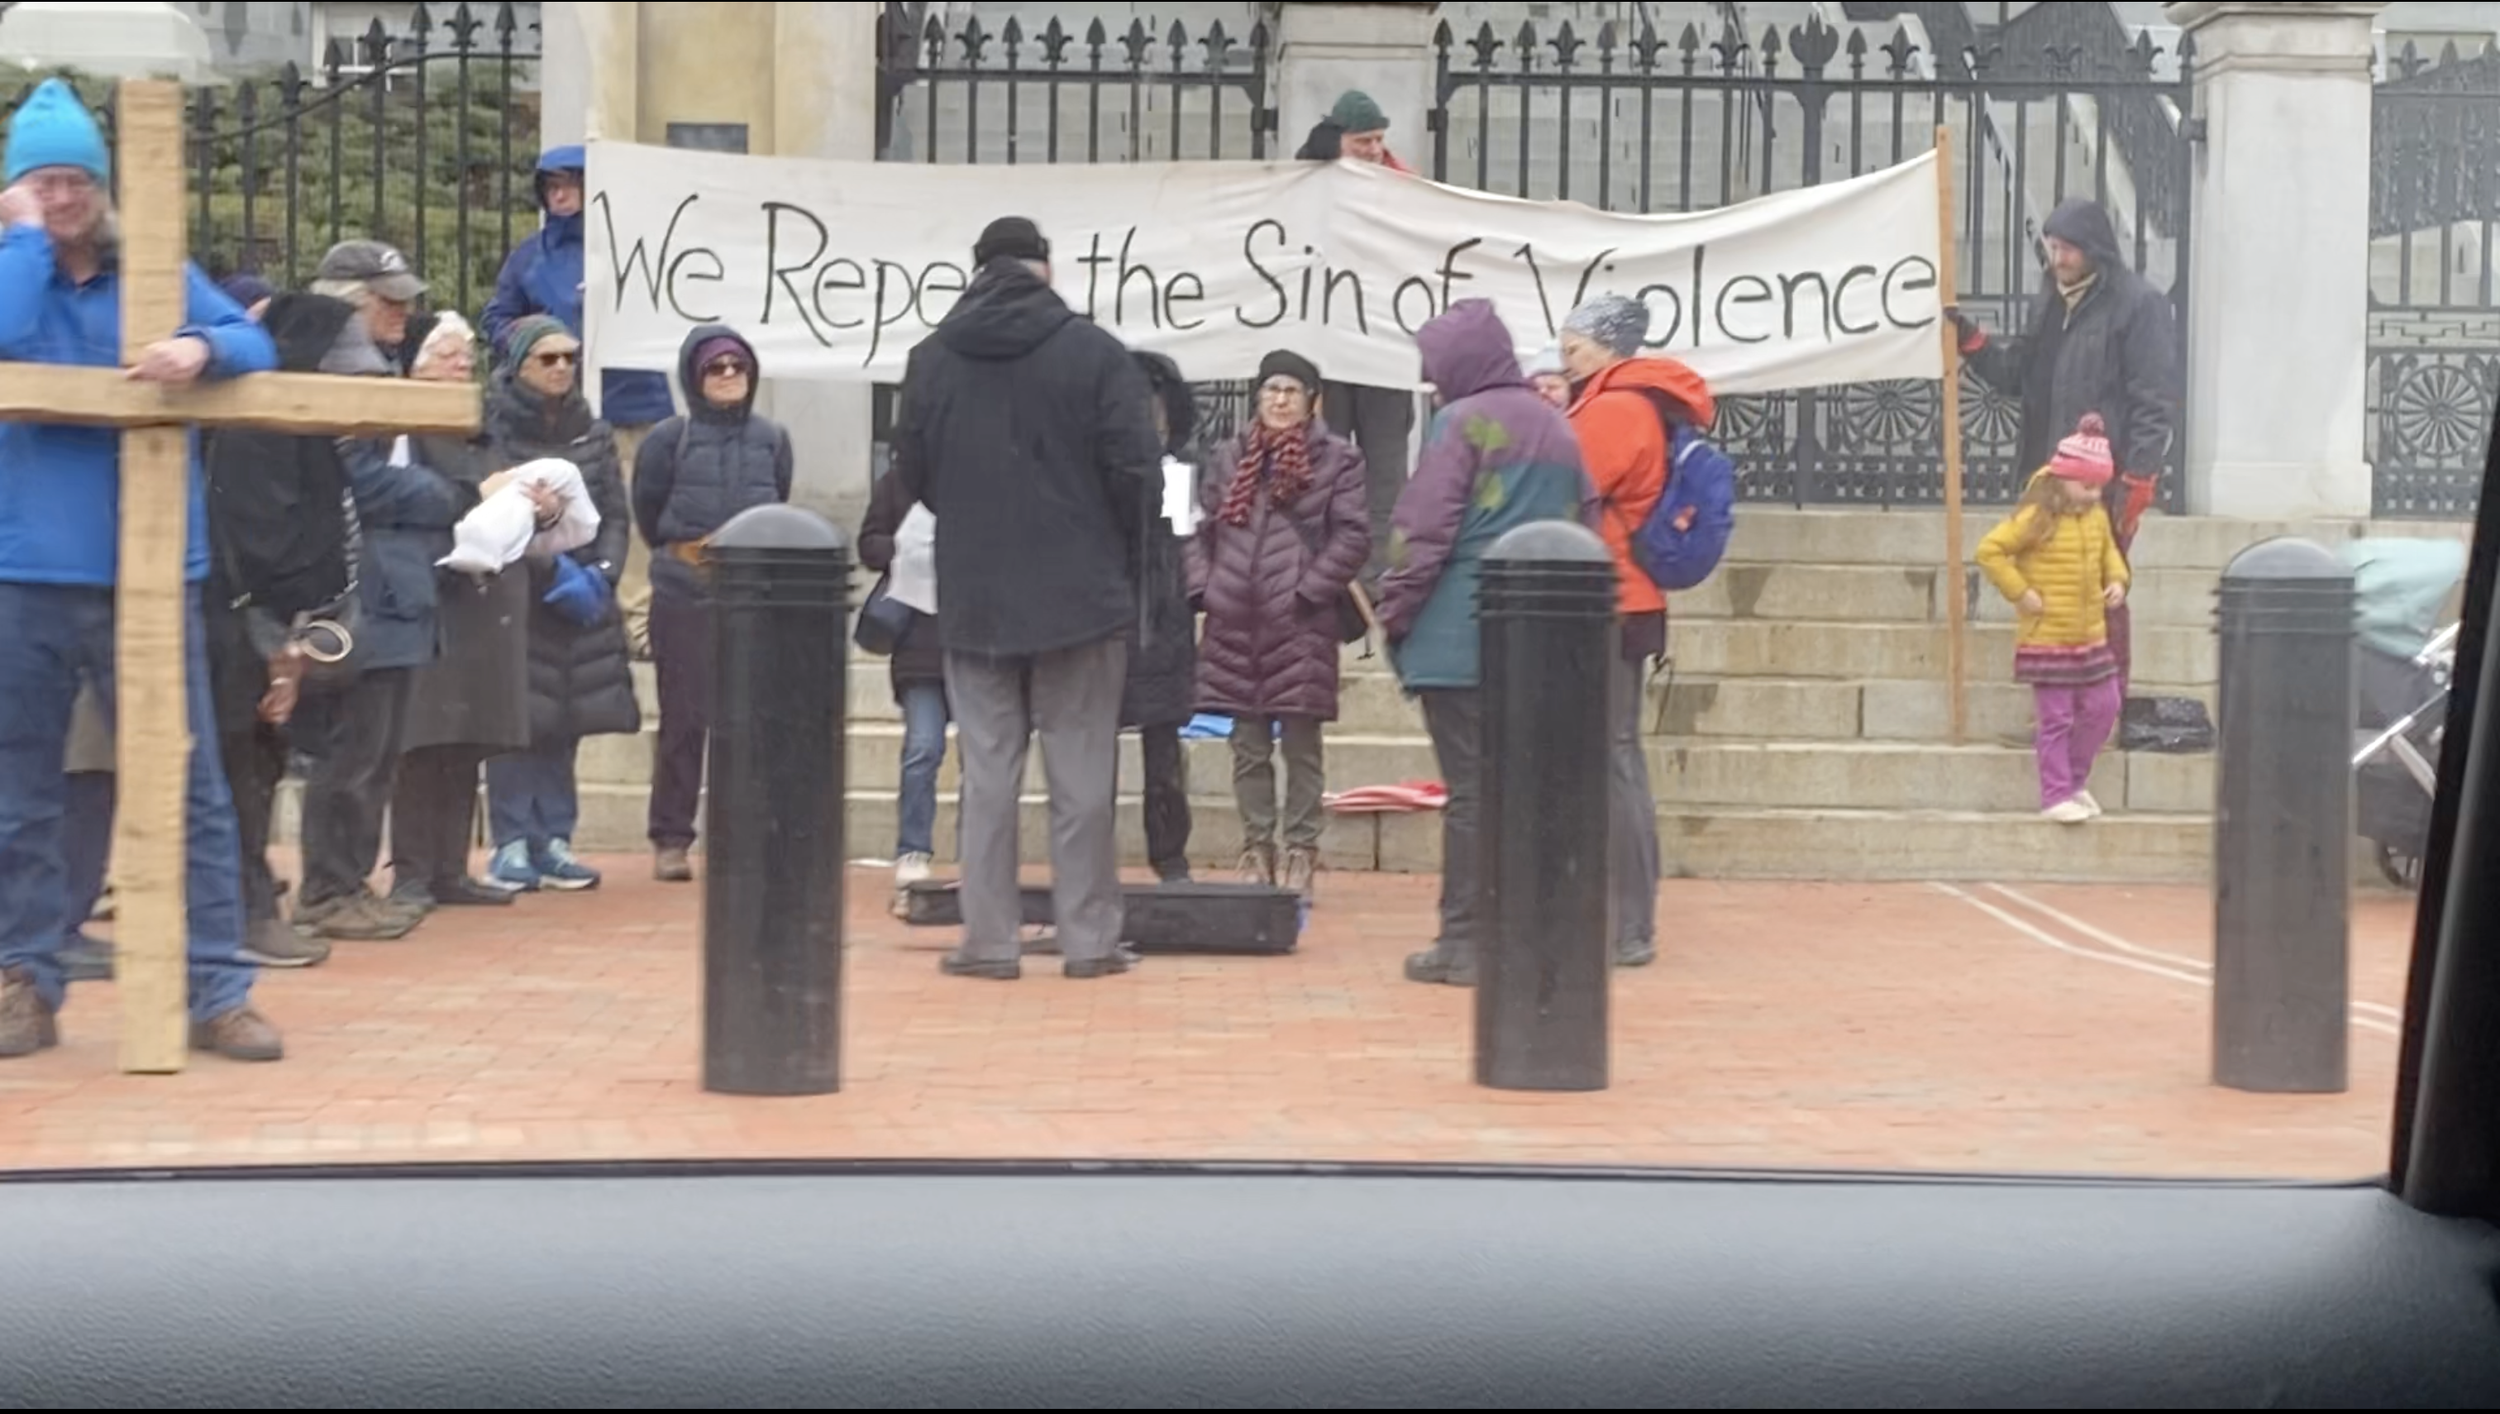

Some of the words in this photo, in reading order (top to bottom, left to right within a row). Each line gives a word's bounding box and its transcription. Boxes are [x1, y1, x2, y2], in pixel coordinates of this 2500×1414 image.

[591, 189, 725, 323] We
[760, 201, 968, 370] Repe
[1076, 225, 1206, 331] the
[1235, 218, 1369, 336] Sin
[1392, 237, 1482, 336] of
